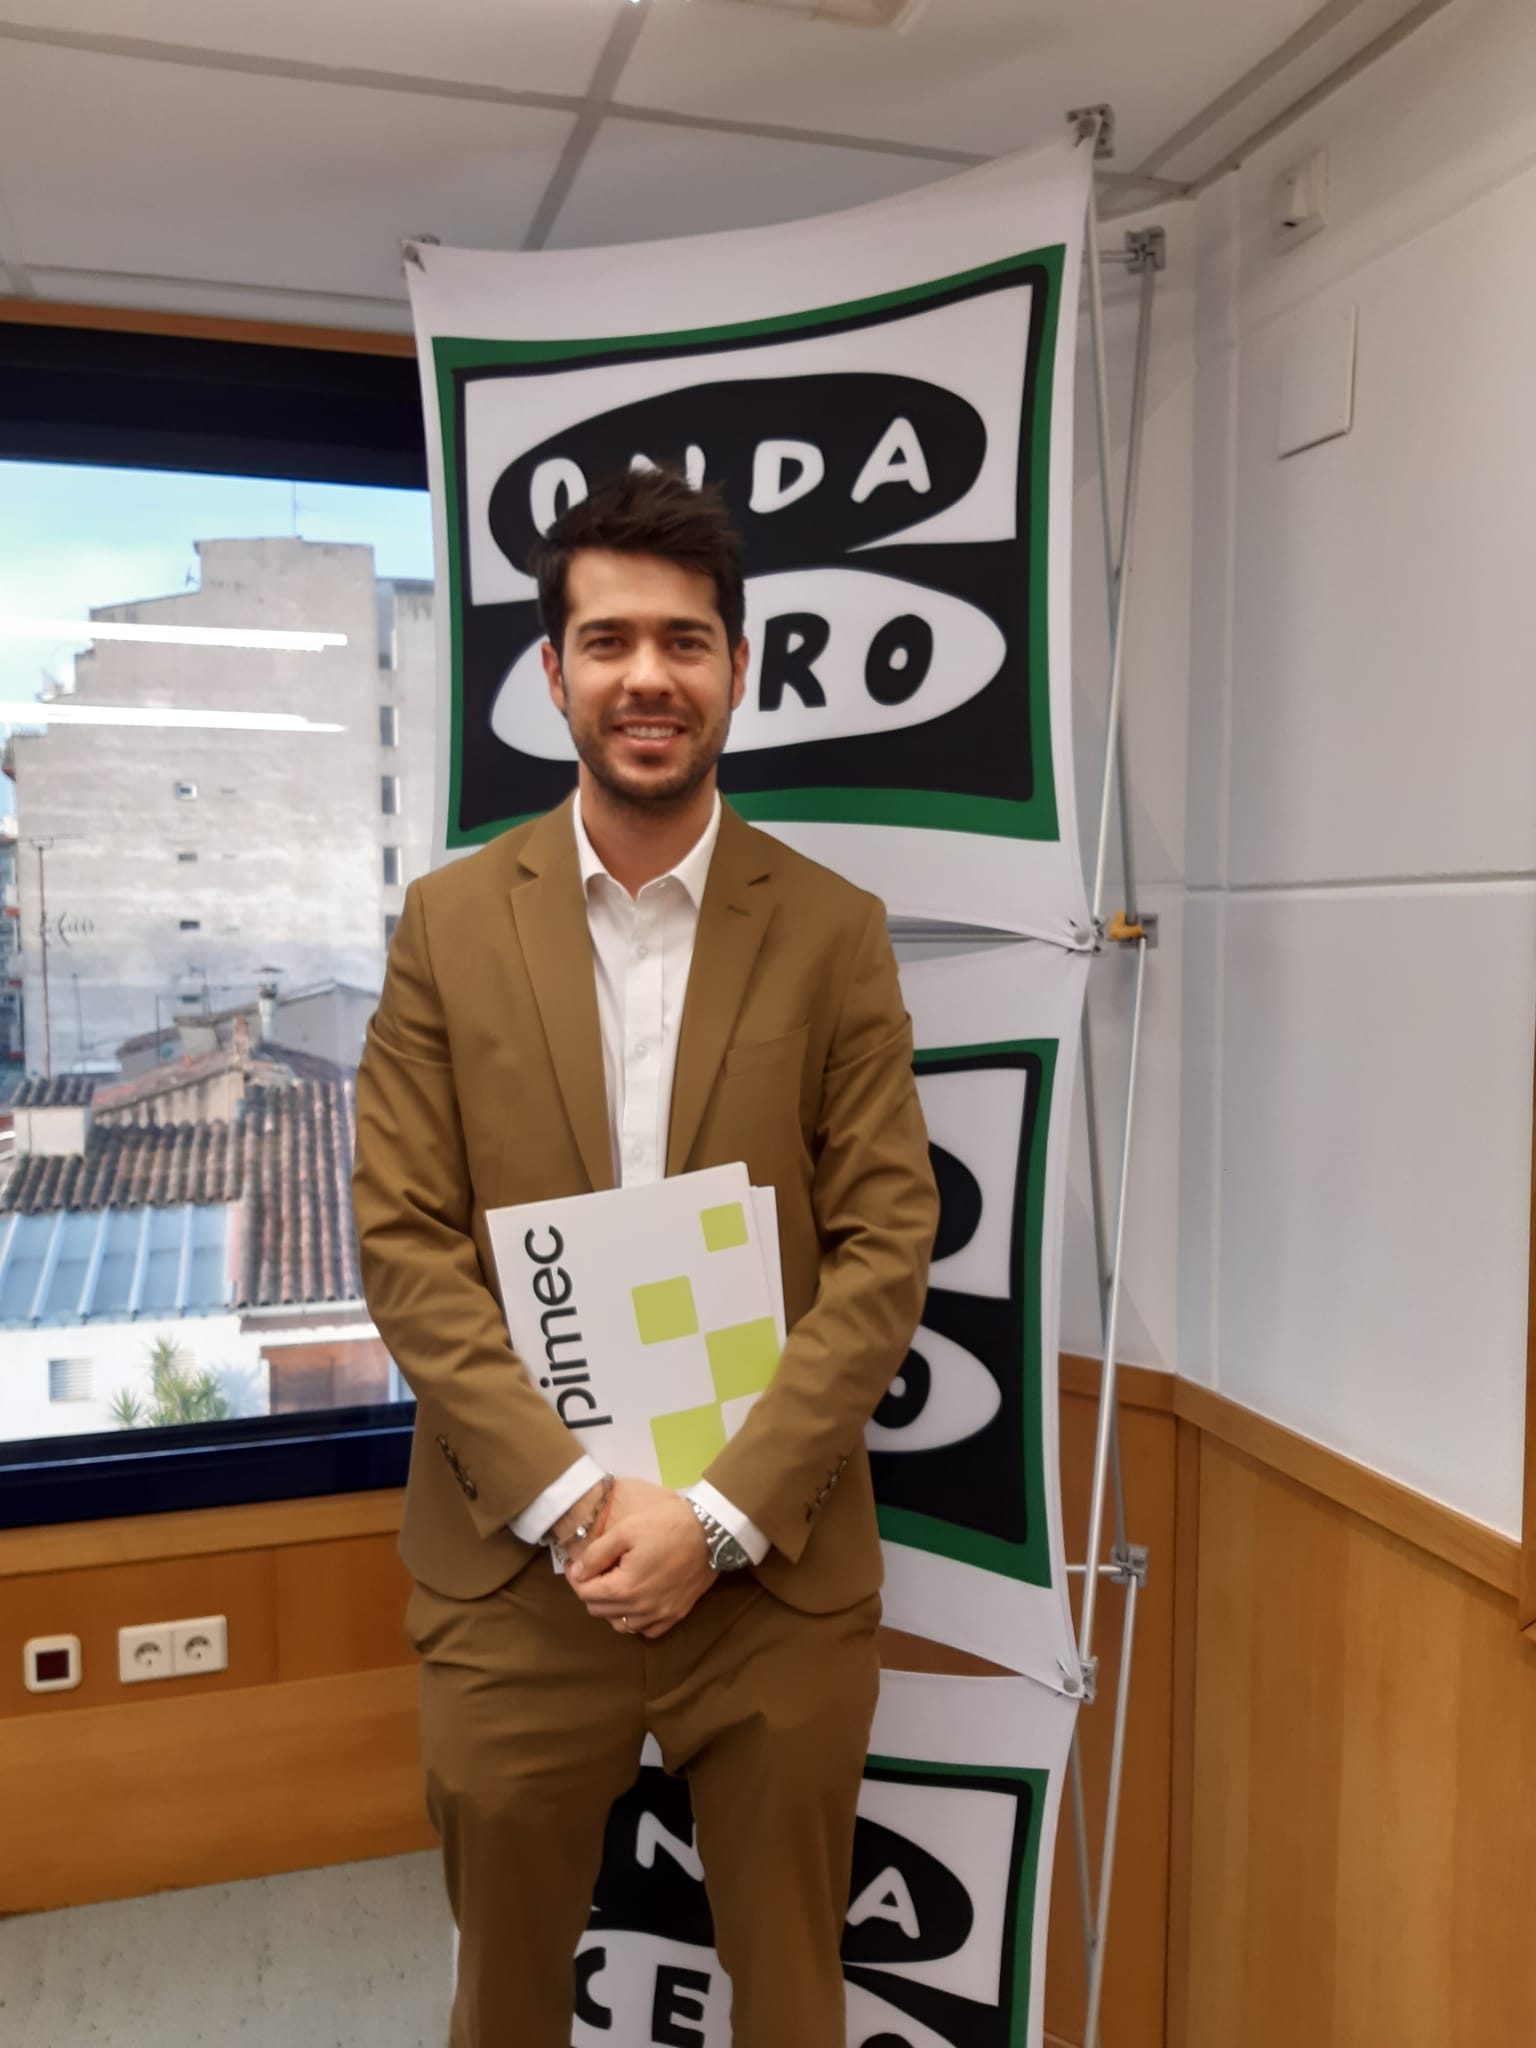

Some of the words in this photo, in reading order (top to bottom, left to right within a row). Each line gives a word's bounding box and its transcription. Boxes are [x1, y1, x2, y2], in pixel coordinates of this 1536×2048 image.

[758, 612, 933, 712] RO
[524, 1224, 613, 1430] pimec
[635, 1811, 921, 1940] NA
